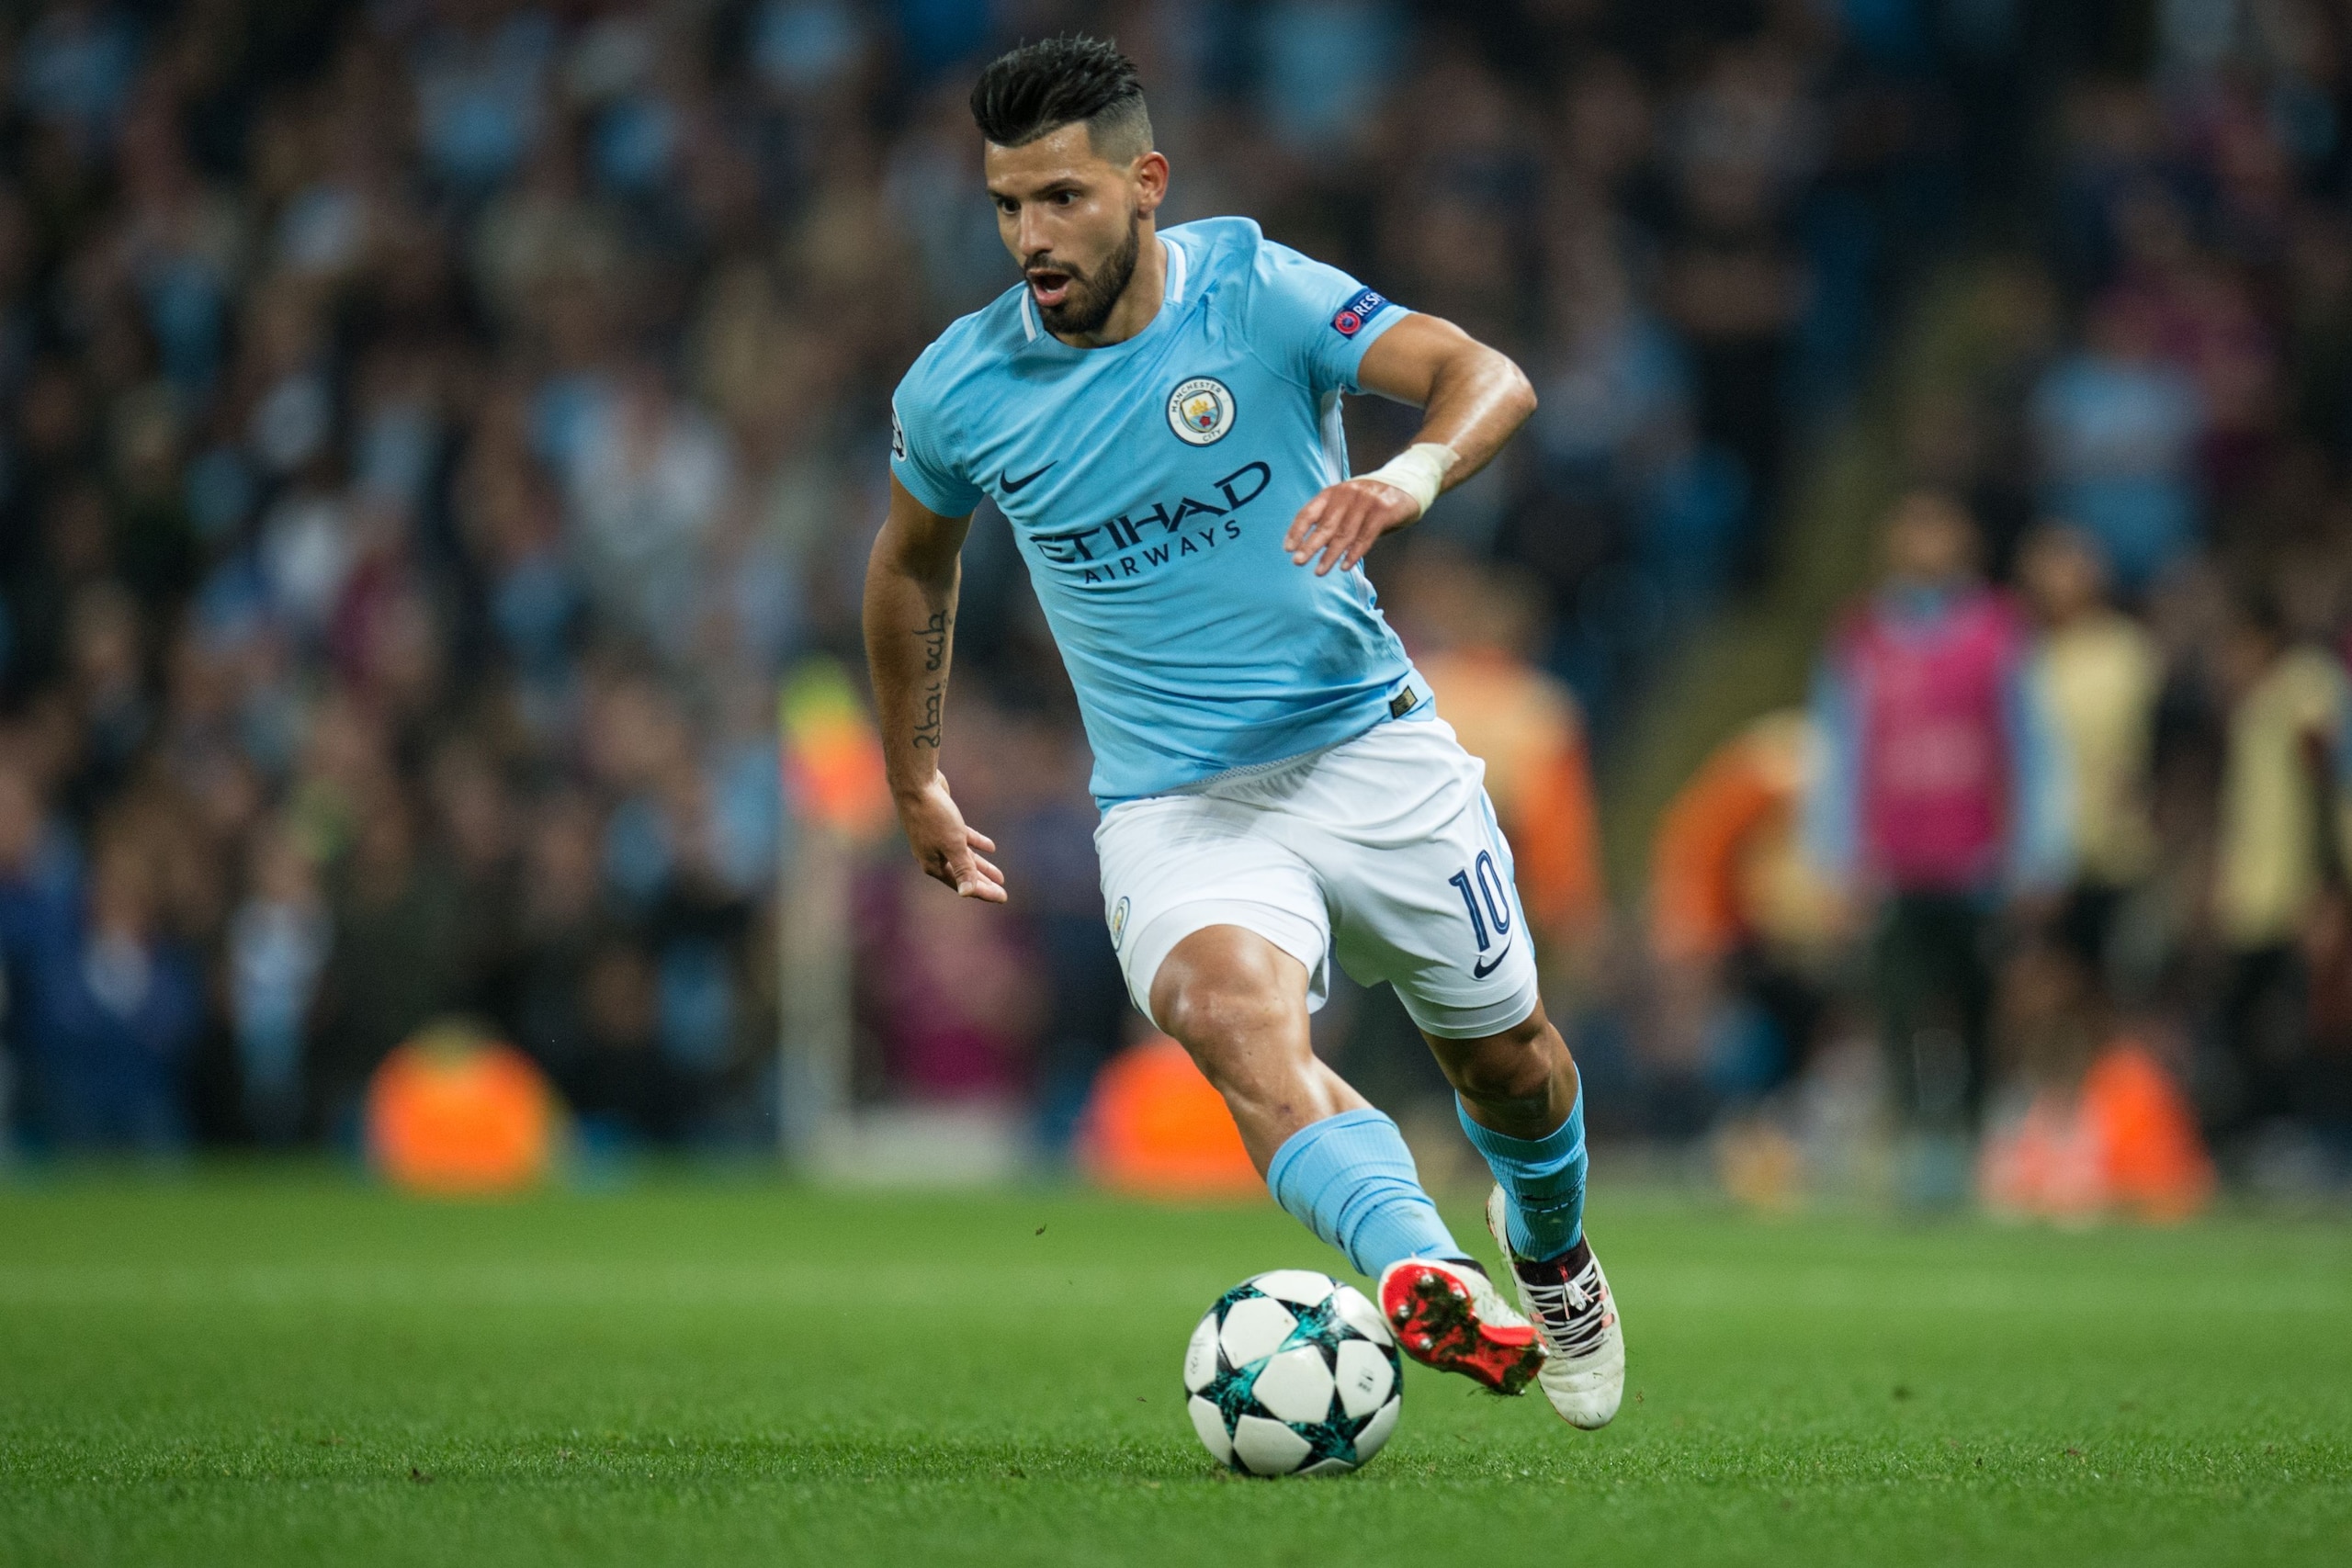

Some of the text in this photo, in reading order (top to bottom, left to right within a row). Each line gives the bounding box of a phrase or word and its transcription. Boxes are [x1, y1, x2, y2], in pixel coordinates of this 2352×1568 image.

[1171, 381, 1222, 412] MANCHESTER
[1203, 428, 1221, 443] CITY
[1029, 461, 1272, 563] ETIHAD
[1085, 519, 1240, 584] AIRWAYS
[1448, 849, 1510, 953] 10
